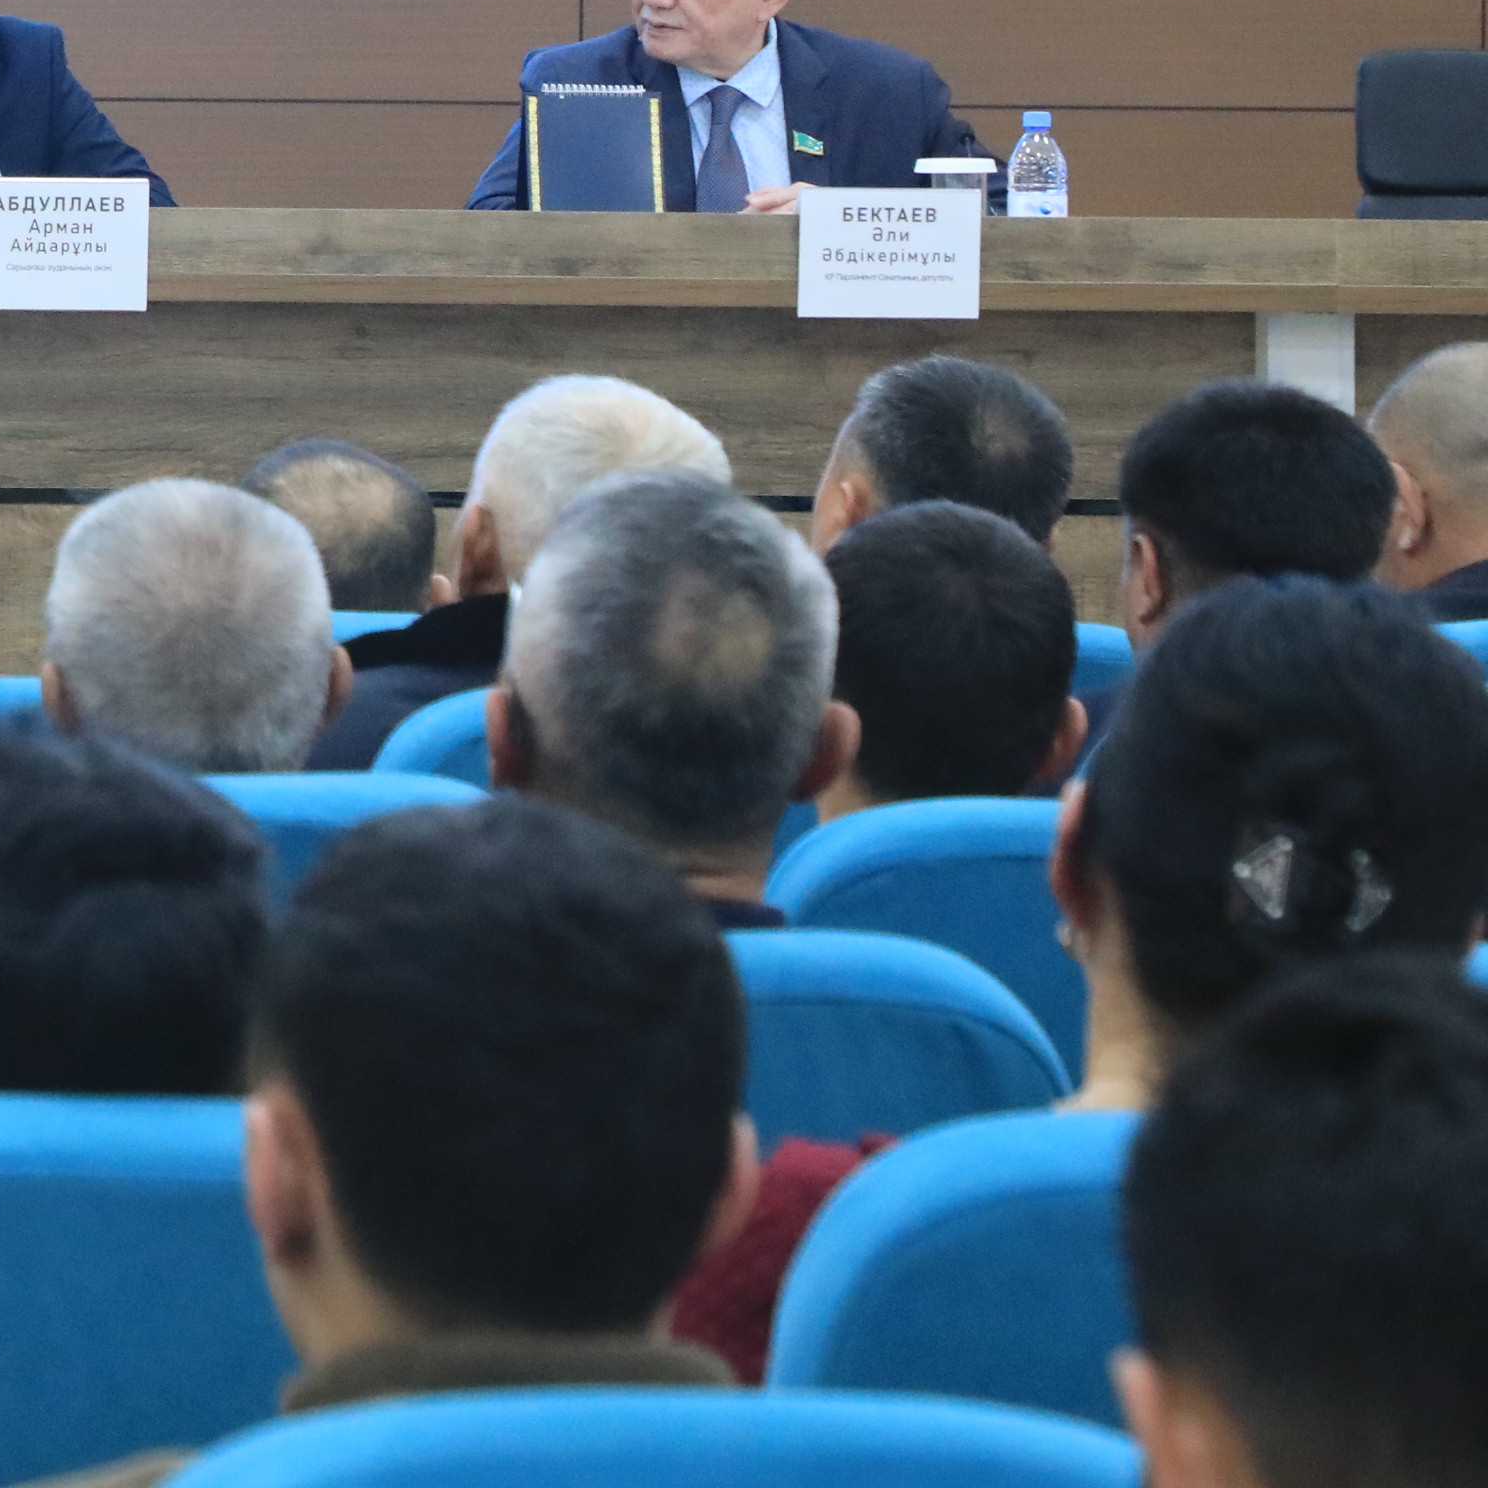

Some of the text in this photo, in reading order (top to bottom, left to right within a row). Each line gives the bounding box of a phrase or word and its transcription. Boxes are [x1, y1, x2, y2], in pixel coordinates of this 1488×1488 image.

[842, 206, 938, 223] БЕКТАЕВ
[28, 218, 93, 237] Арман
[872, 226, 910, 242] Әли
[10, 237, 107, 257] Айдарұлы
[822, 247, 956, 266] Әбдікерімұлы
